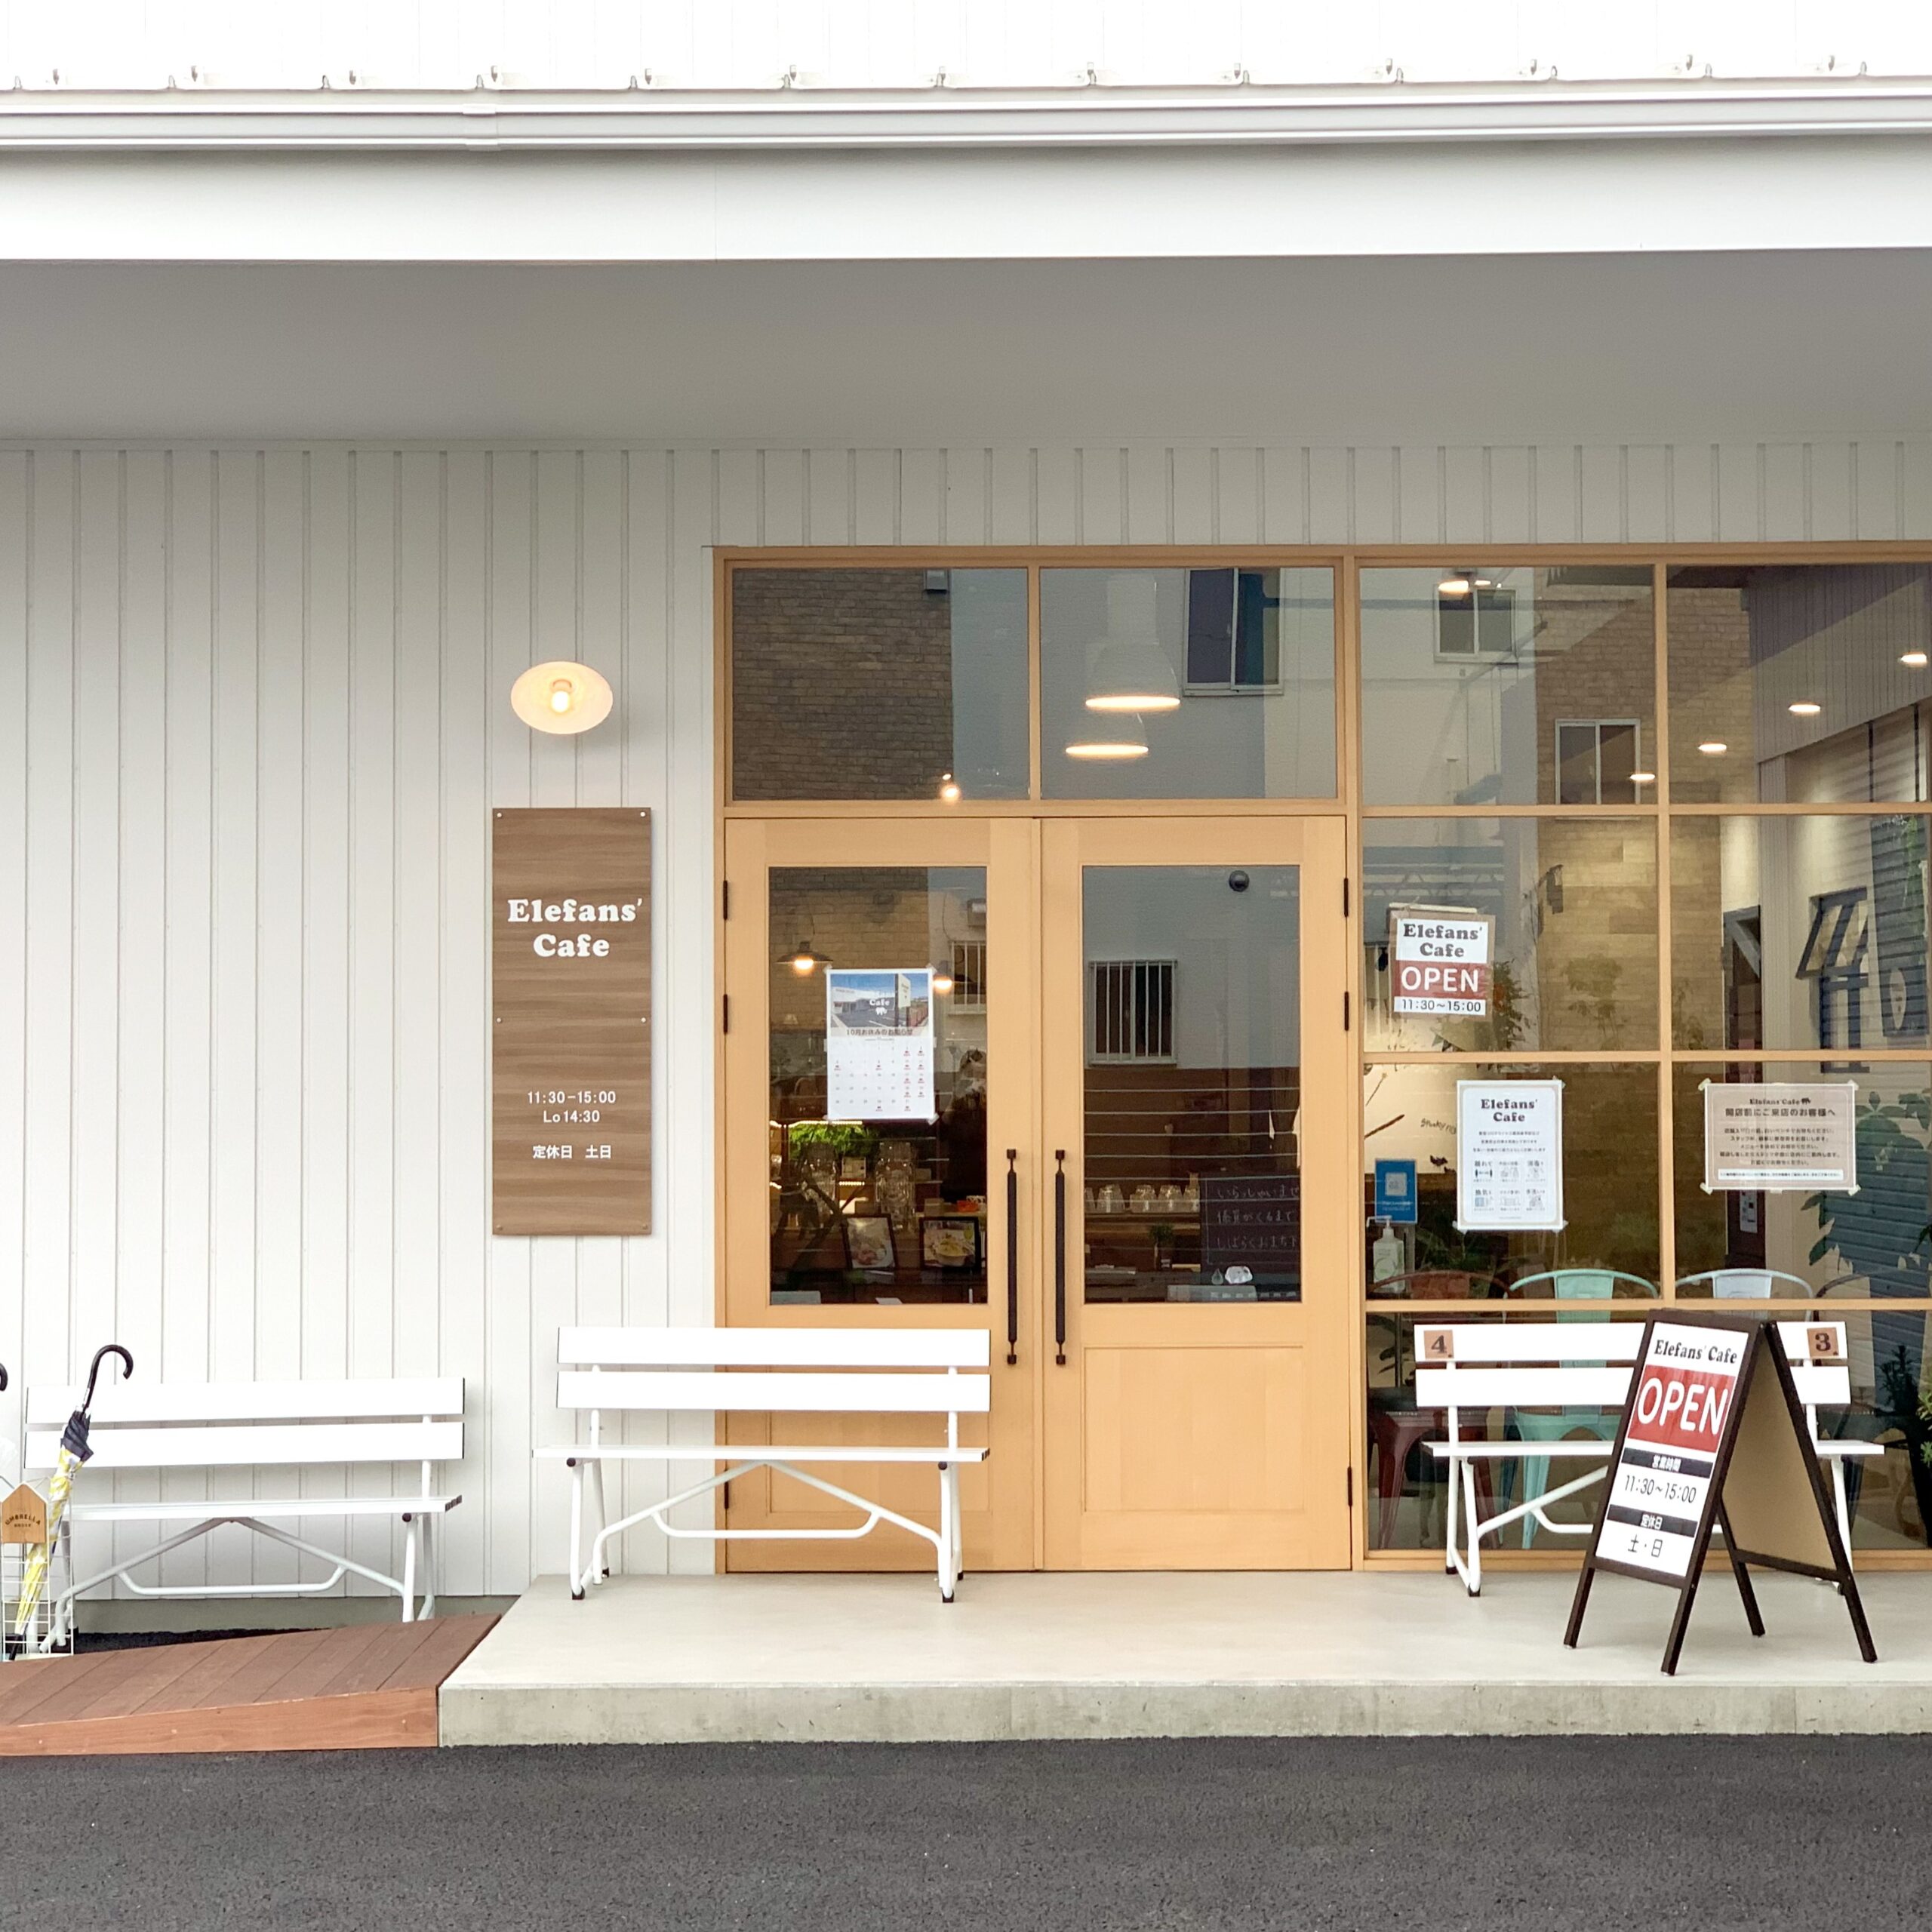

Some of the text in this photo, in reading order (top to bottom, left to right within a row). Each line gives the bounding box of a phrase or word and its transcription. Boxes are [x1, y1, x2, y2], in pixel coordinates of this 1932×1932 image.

[507, 897, 643, 923] Elefans'
[1403, 923, 1483, 940] Elefans'
[533, 934, 611, 958] Cafe
[1420, 942, 1464, 958] Cafe
[1401, 966, 1479, 992] OPEN
[563, 1110, 601, 1124] 14:30
[1493, 1112, 1525, 1122] Cafe
[532, 1145, 612, 1160] 定休日 土日
[1431, 1334, 1447, 1354] 4
[1814, 1333, 1832, 1352] 3
[1708, 1345, 1738, 1364] Cafe
[1637, 1377, 1729, 1436] OPEN
[5, 1514, 41, 1525] UMBRELLA
